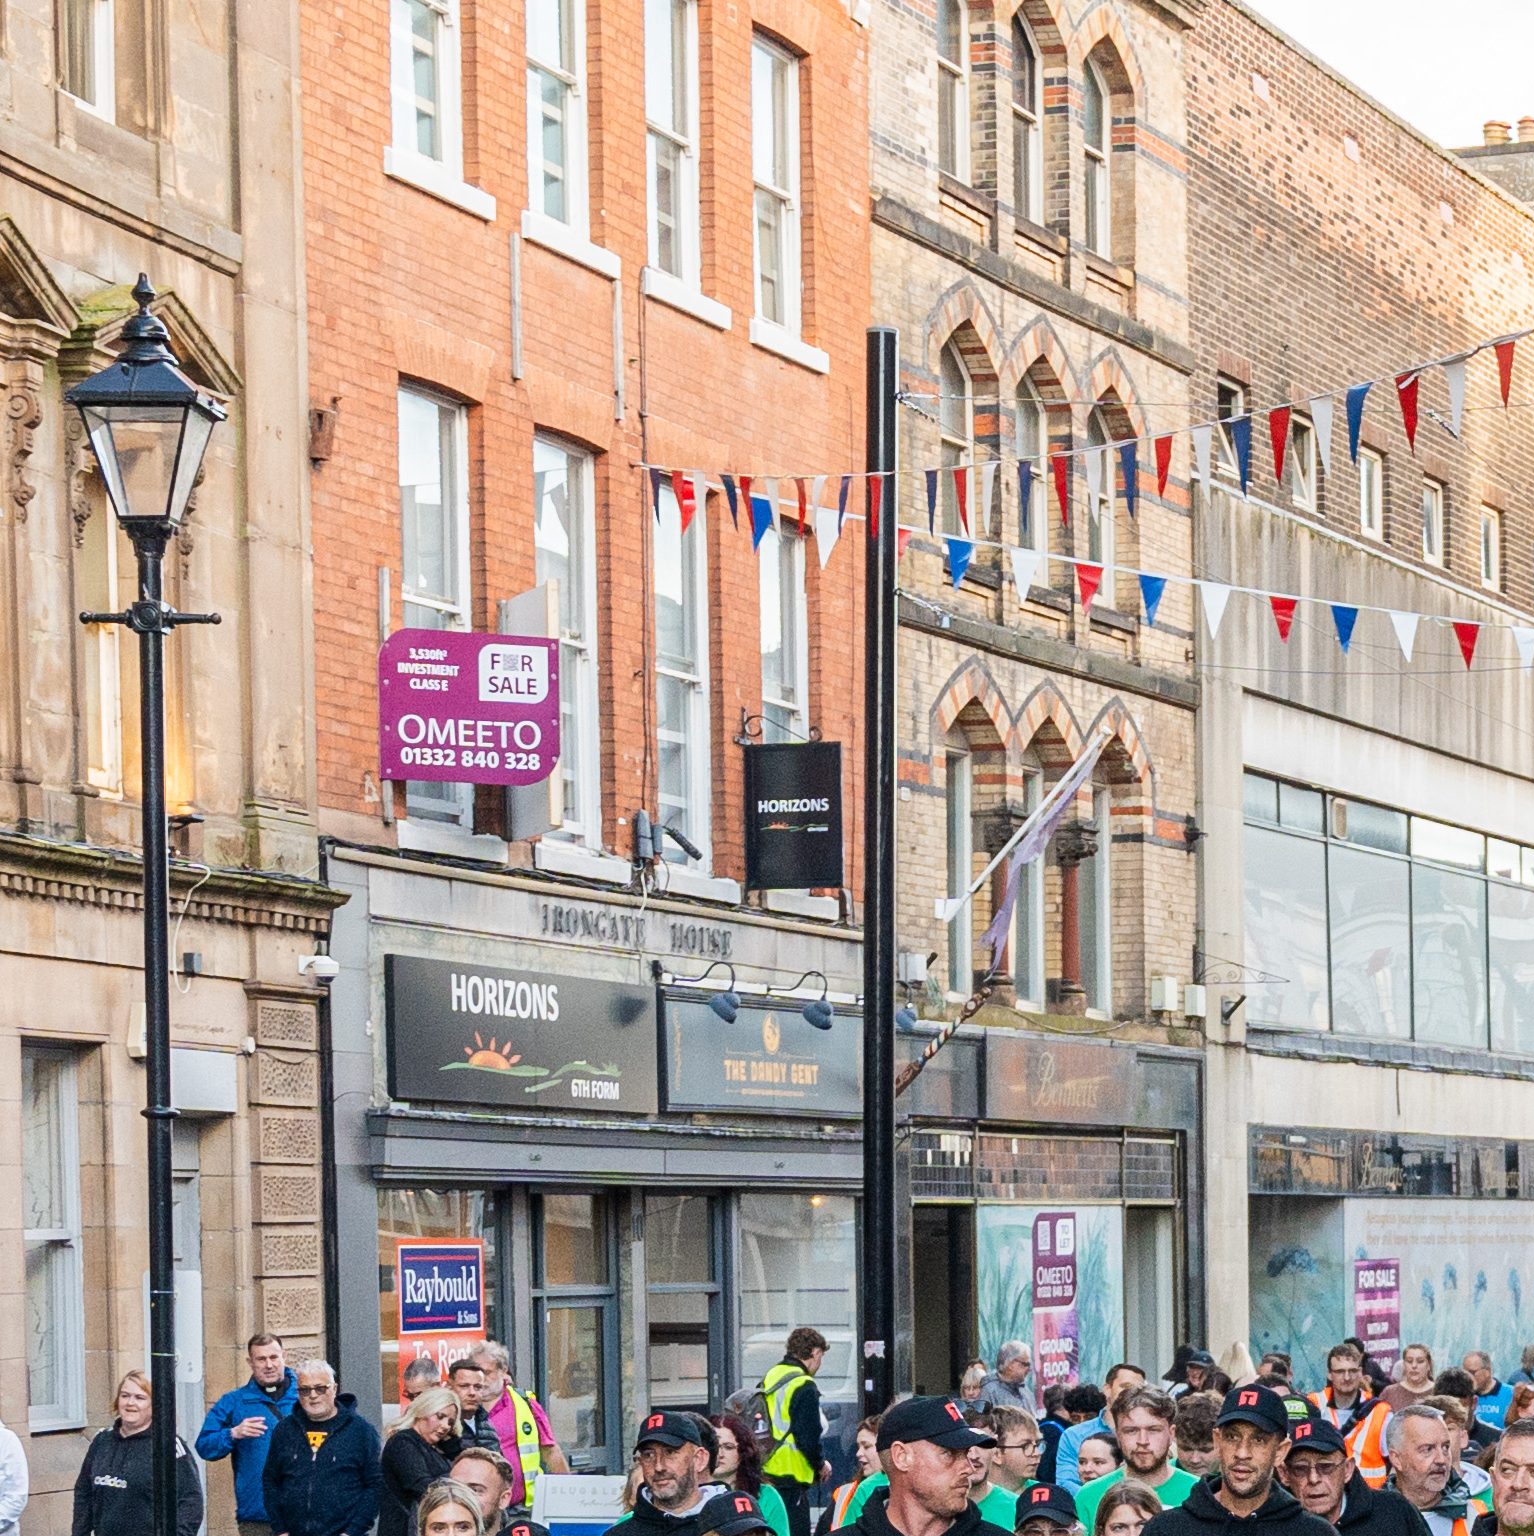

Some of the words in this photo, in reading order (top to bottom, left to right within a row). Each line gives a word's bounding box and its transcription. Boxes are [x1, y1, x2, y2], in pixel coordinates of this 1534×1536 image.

[397, 662, 460, 677] INVESTMENT
[409, 677, 441, 691] CLASS
[441, 679, 449, 691] E
[488, 676, 538, 695] SALE
[397, 714, 542, 750] OMEETO
[400, 746, 456, 767] 01332
[460, 750, 500, 769] 840
[504, 752, 541, 770] 328
[757, 798, 830, 814] HORIZONS
[541, 904, 646, 948] IRONGATE
[669, 922, 734, 959] HOUSE
[450, 973, 560, 1022] HORIZONS
[723, 1059, 747, 1081] THE
[571, 1078, 591, 1099] 6TH
[591, 1080, 620, 1101] FORM
[1036, 1265, 1073, 1285] OMEETO
[1358, 1270, 1376, 1289] FOR
[1376, 1268, 1397, 1287] SALE
[404, 1265, 478, 1312] Raybould
[464, 1310, 478, 1325] Sons
[1040, 1337, 1073, 1355] GROUND
[1043, 1360, 1070, 1378] FLOOR
[94, 1475, 128, 1489] adidas
